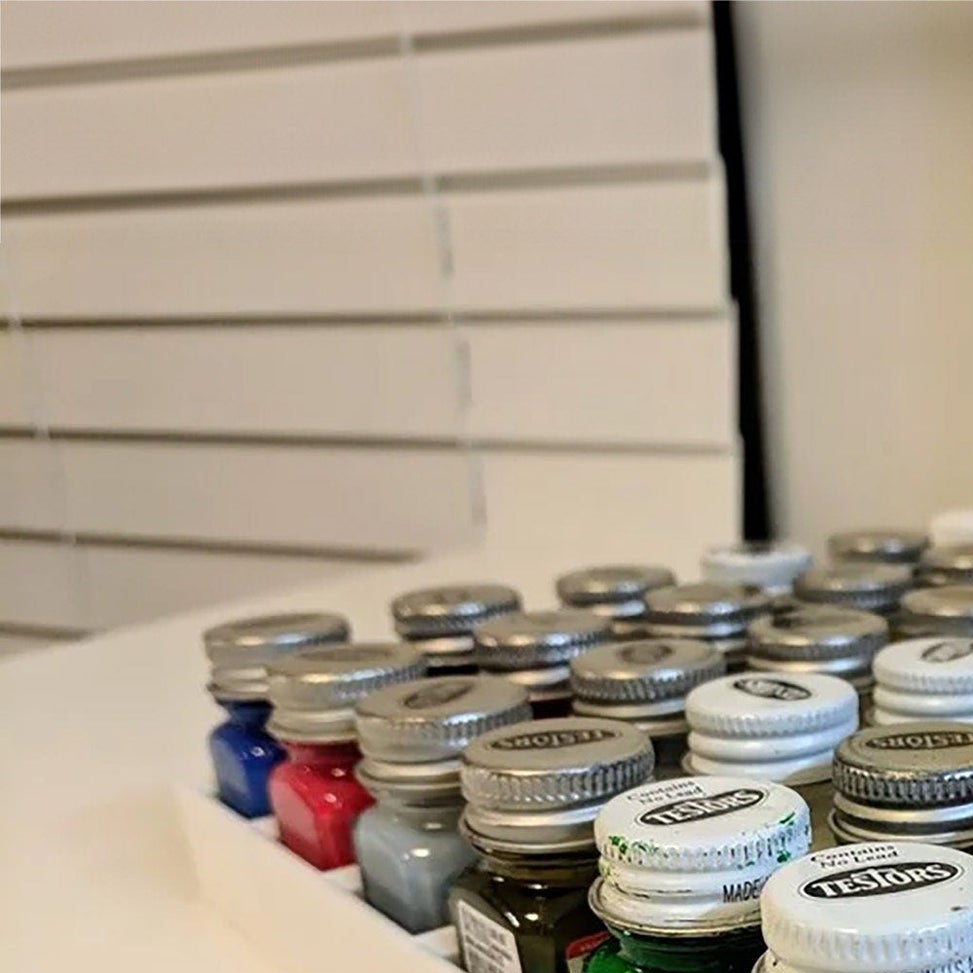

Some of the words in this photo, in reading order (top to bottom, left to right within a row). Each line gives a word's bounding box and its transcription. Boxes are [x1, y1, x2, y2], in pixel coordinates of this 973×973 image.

[645, 790, 757, 825] TESTORS
[810, 844, 895, 863] Contains
[820, 858, 850, 869] No
[853, 850, 899, 864] Lead
[722, 880, 762, 903] MADE
[811, 863, 952, 897] TESTORS
